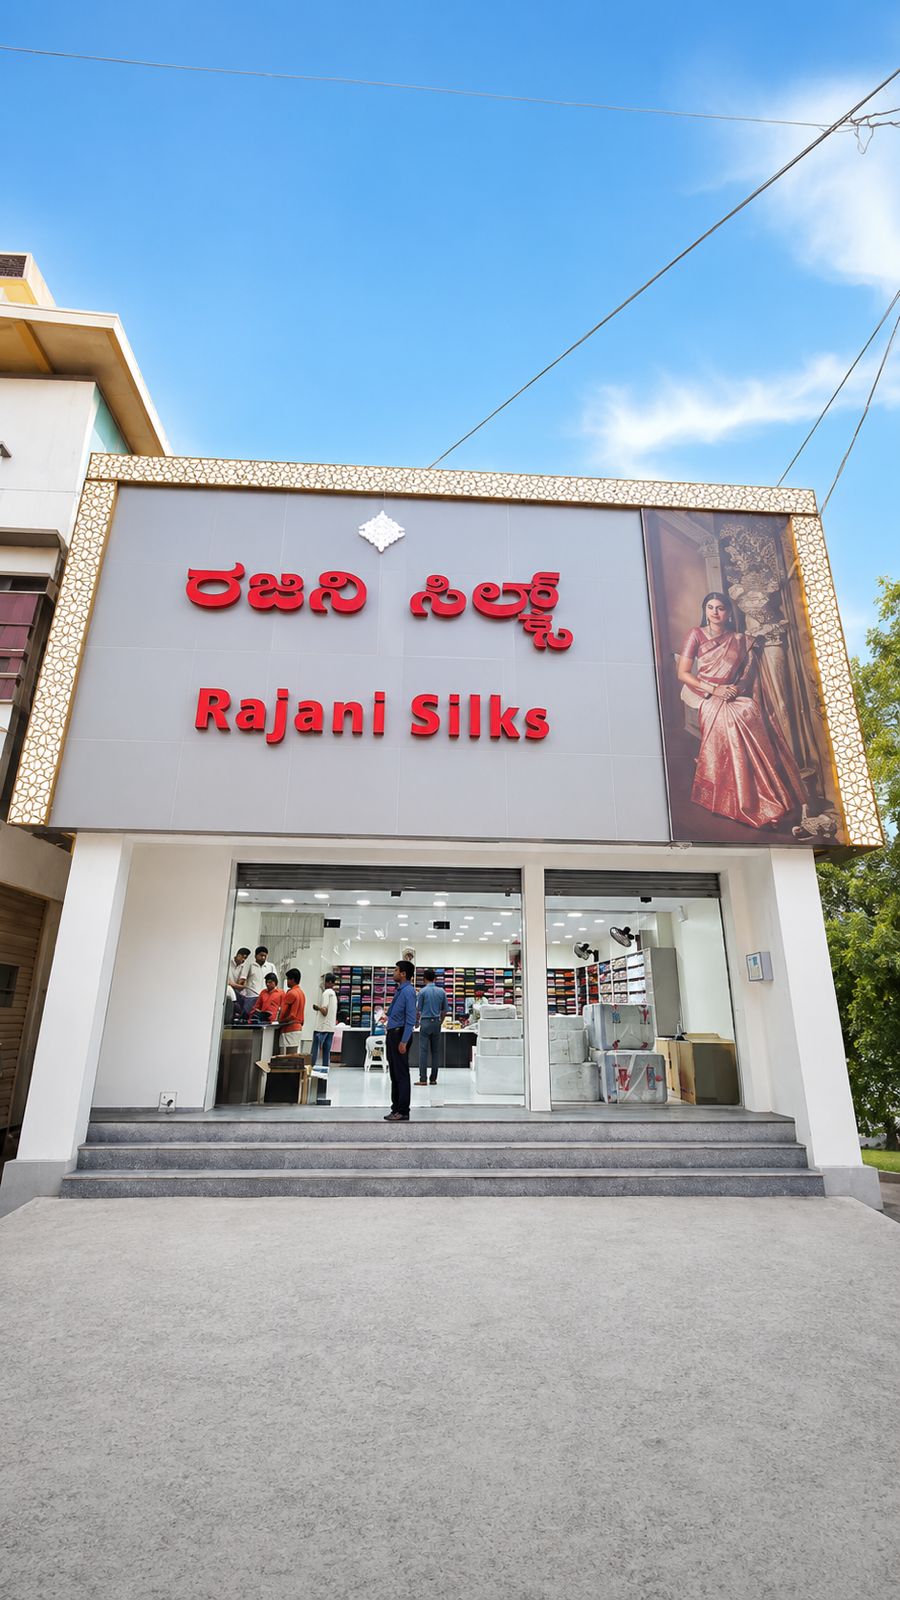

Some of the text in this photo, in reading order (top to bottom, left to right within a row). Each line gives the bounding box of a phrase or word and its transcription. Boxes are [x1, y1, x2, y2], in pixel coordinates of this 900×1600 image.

[186, 562, 367, 615] ರಜನಿ
[195, 688, 551, 745] Rajani Silks
